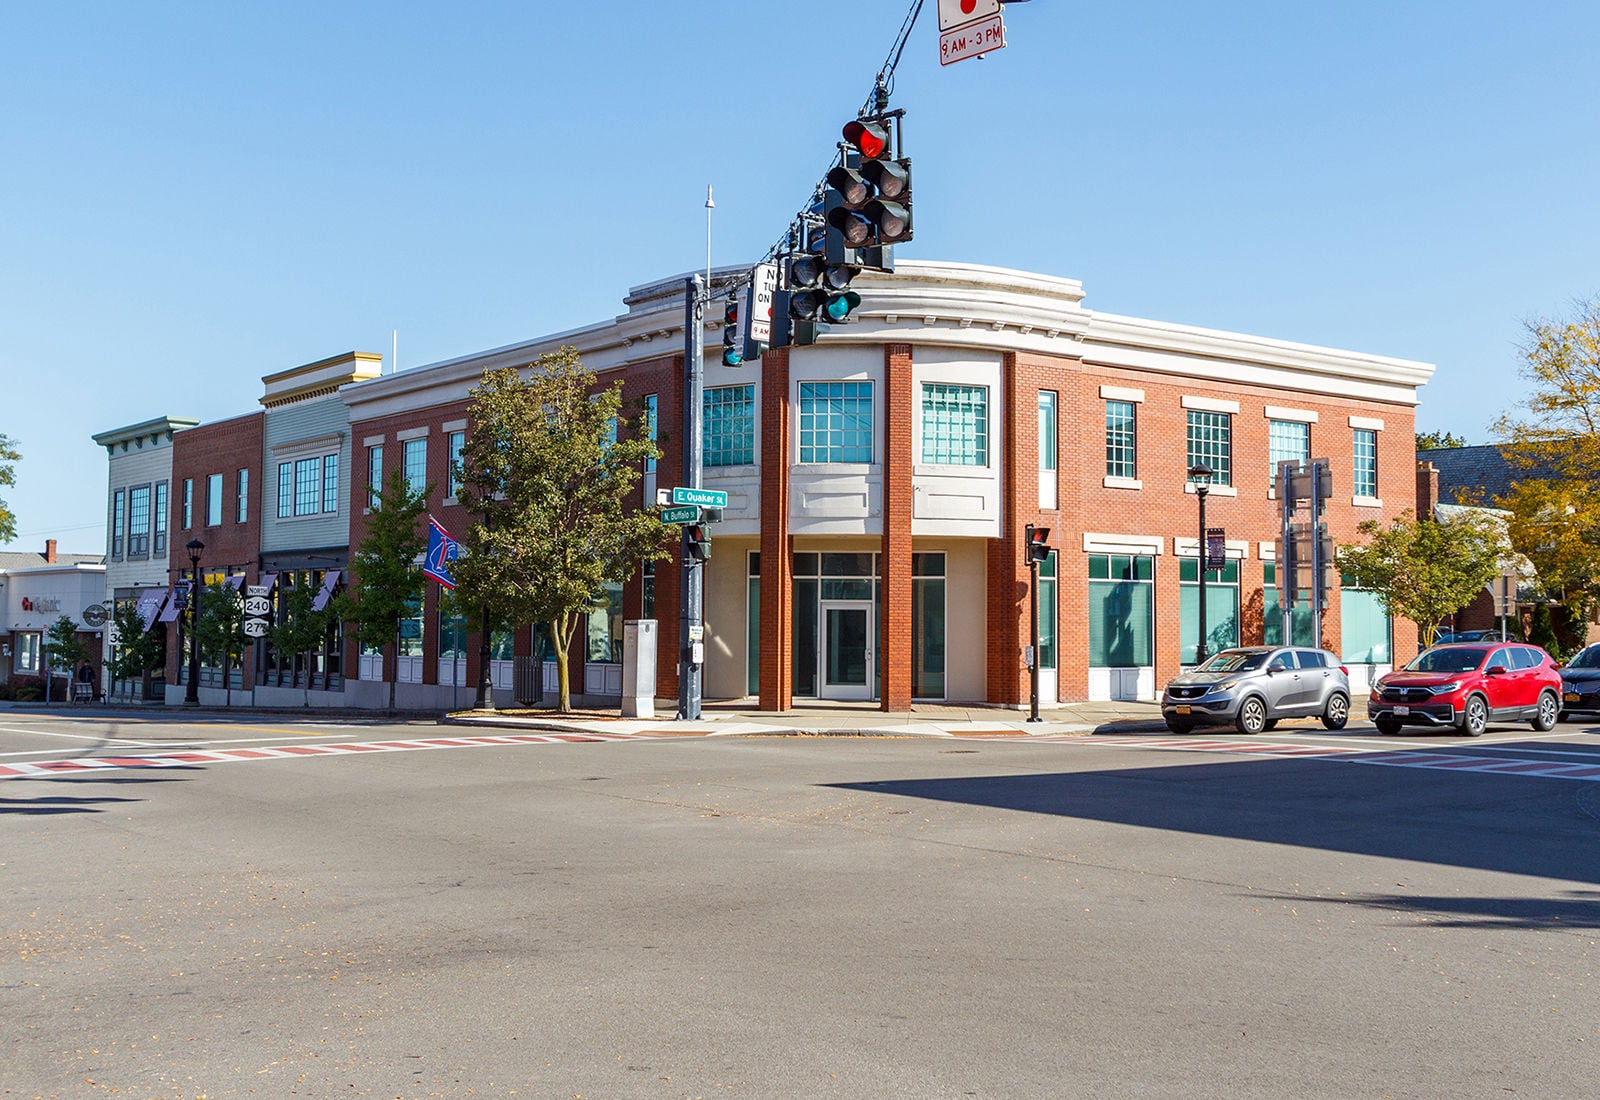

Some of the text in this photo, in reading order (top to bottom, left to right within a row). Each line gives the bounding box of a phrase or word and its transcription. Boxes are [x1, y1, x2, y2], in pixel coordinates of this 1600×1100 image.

[942, 44, 948, 55] 9
[951, 37, 966, 53] AM
[976, 32, 982, 45] 3
[986, 26, 1001, 42] PM
[767, 269, 783, 281] NO
[758, 293, 770, 304] ON
[678, 491, 685, 501] E
[687, 492, 715, 504] Quaker
[671, 511, 689, 520] Buffalo
[247, 601, 268, 611] 240
